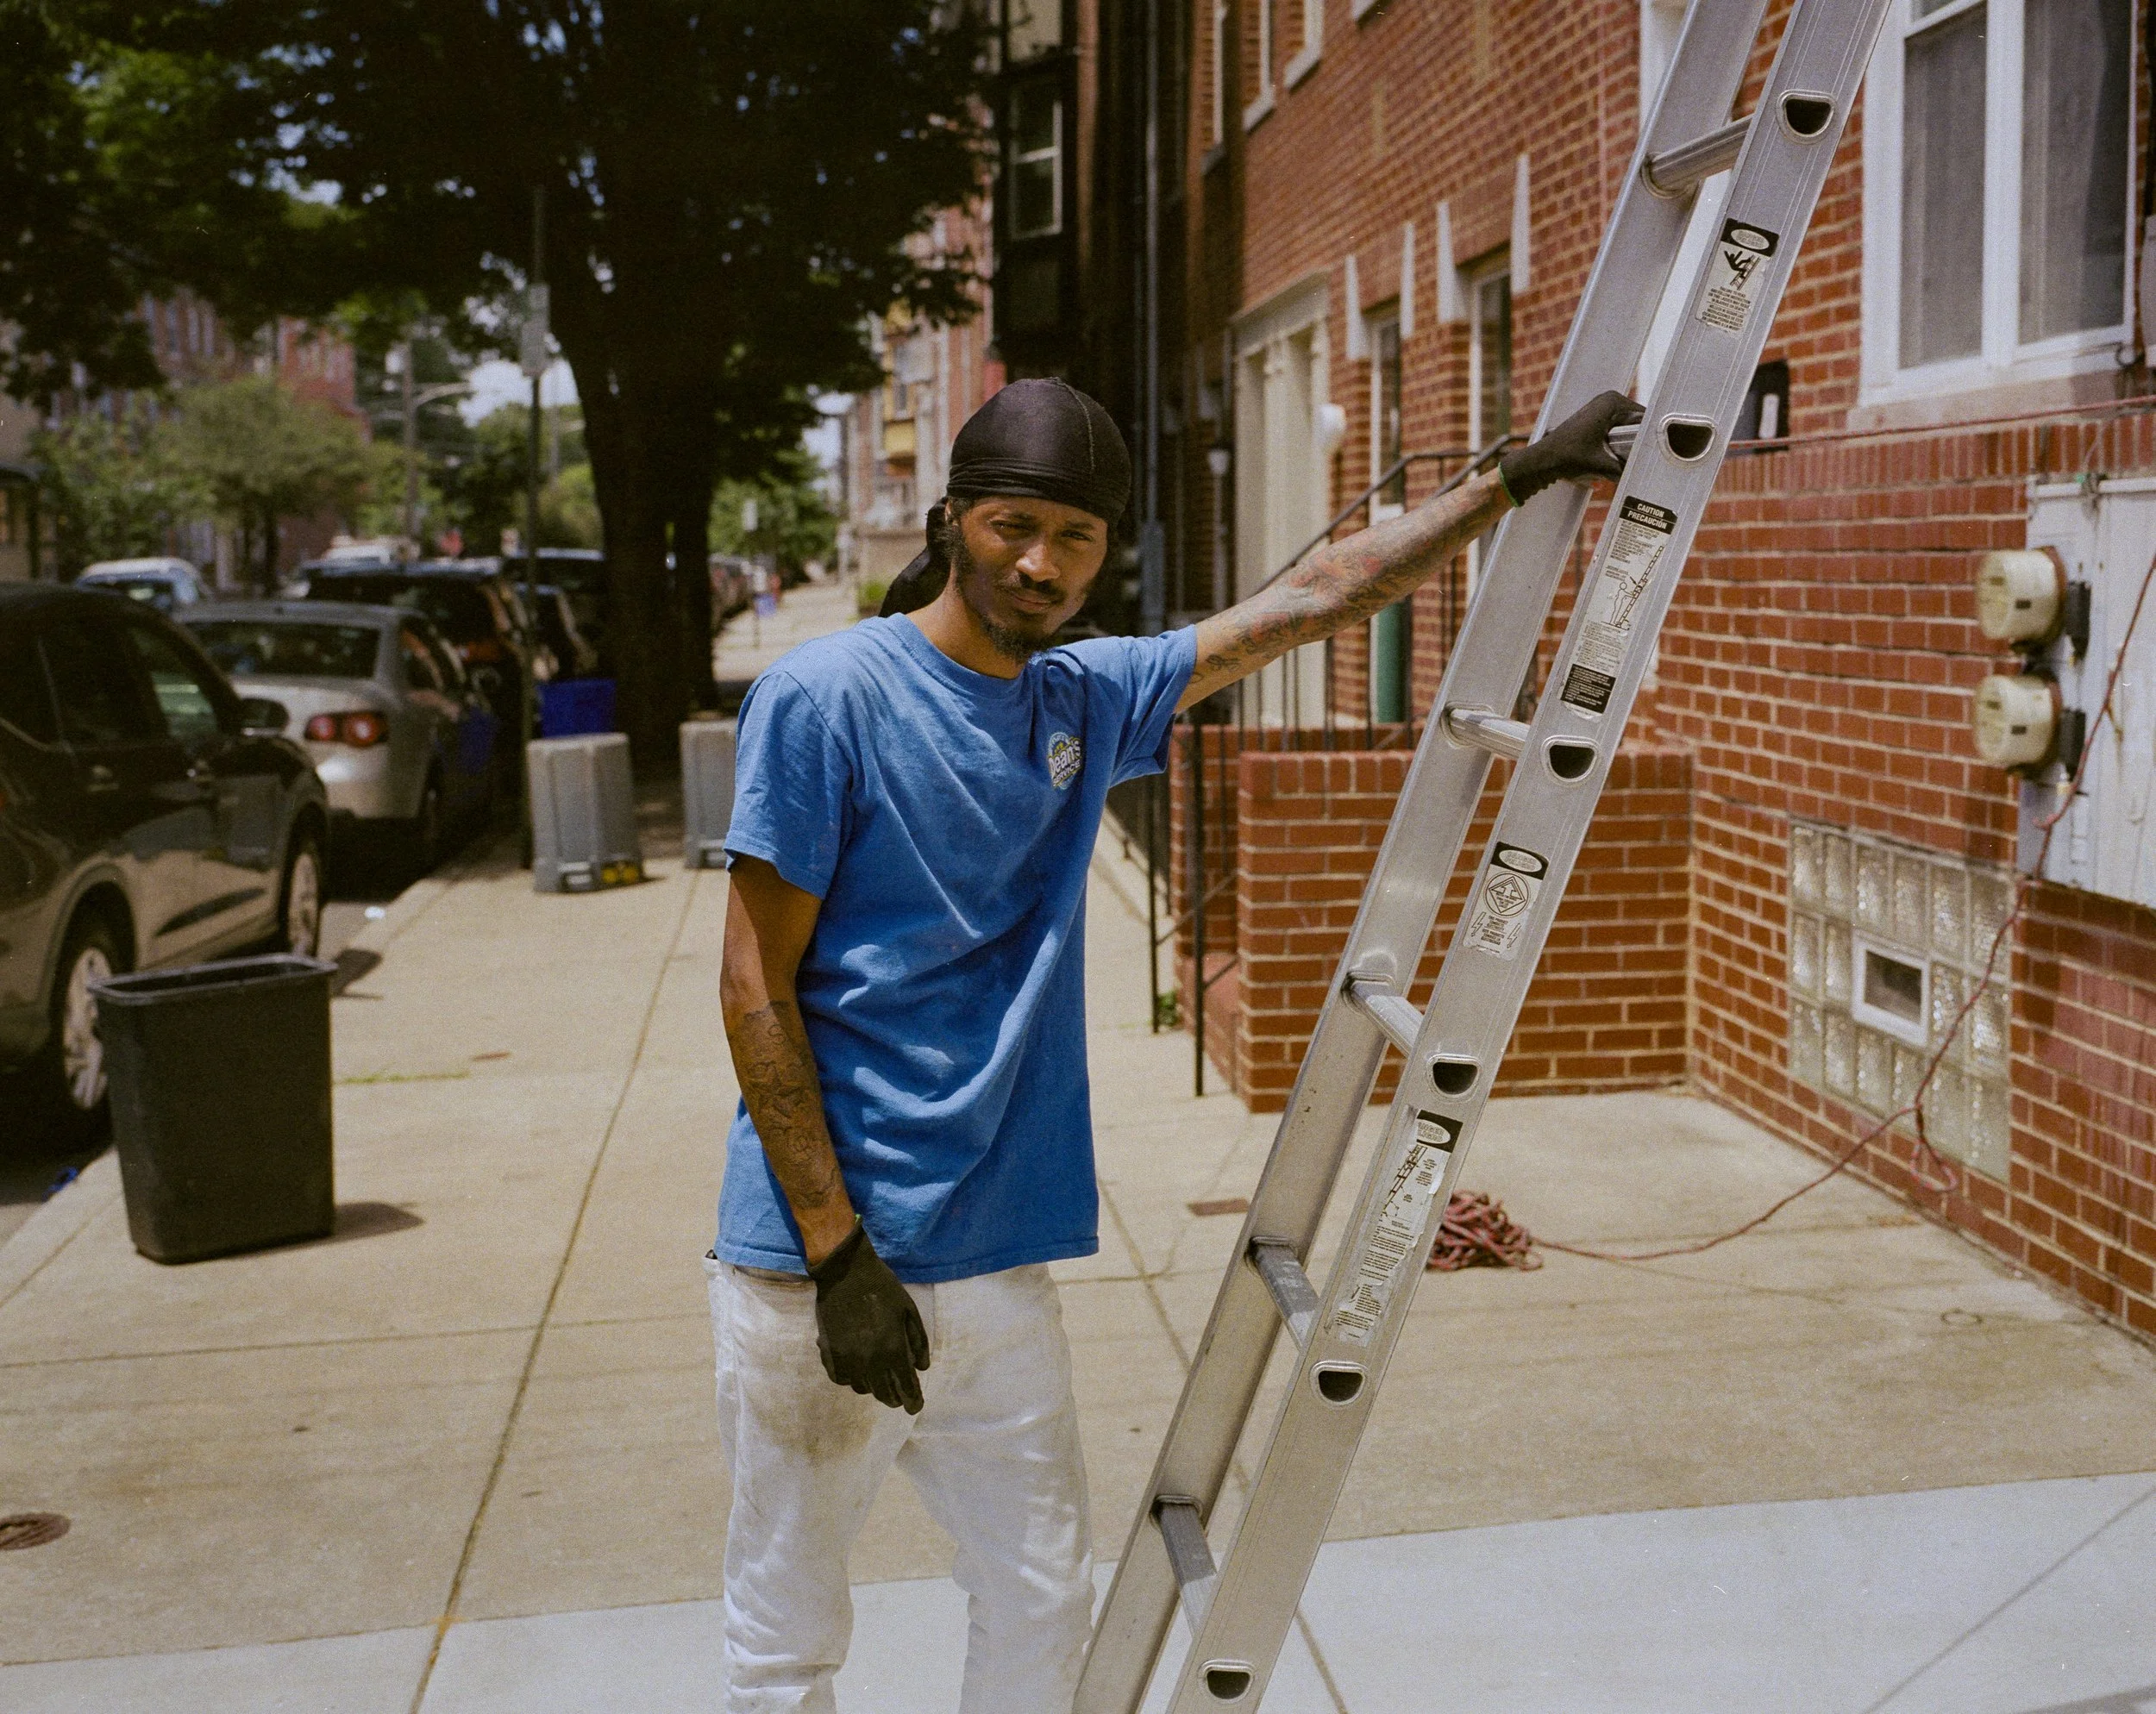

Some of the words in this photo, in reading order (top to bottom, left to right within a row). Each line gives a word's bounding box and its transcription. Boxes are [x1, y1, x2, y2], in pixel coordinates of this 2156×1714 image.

[1627, 510, 1668, 529] PRECAUCIÓN
[1637, 504, 1664, 517] CAUTION
[1048, 740, 1081, 777] Dean's
[1052, 759, 1081, 785] SERVICE
